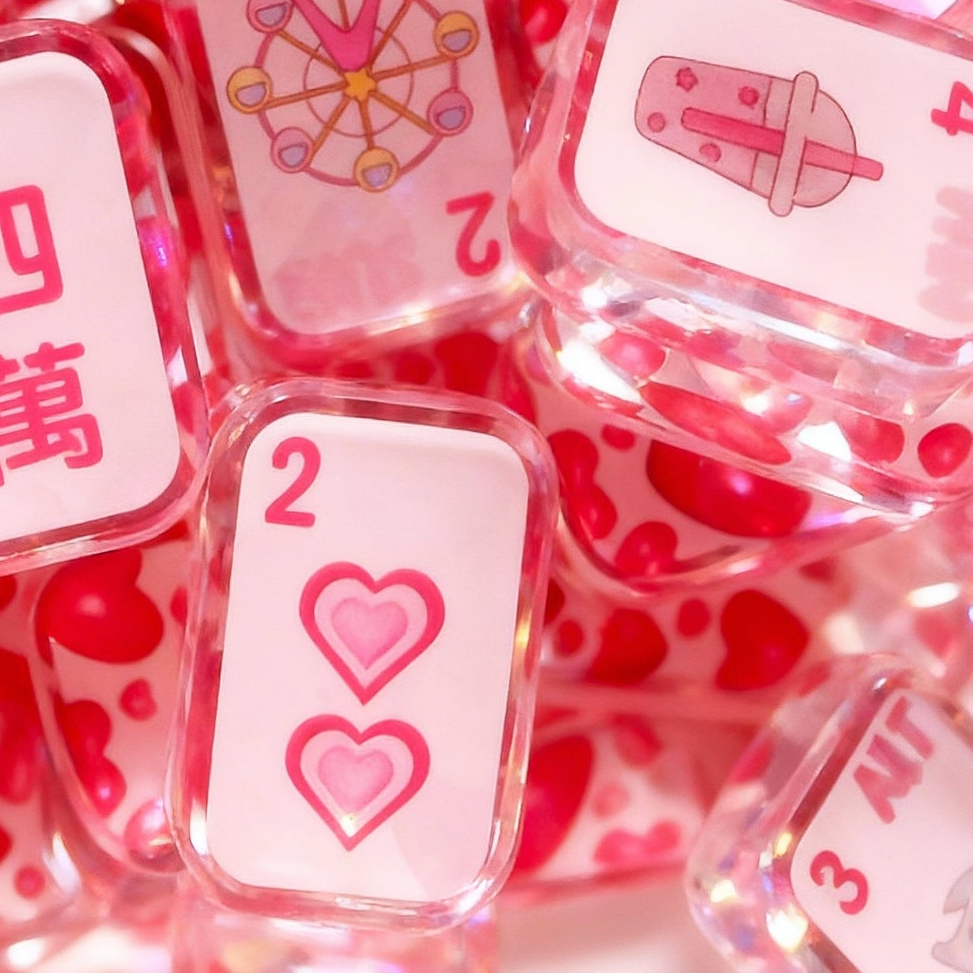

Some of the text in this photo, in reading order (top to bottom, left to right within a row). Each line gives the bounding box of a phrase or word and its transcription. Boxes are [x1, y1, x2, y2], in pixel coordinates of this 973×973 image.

[445, 191, 501, 277] 2
[265, 436, 321, 527] 2
[810, 850, 869, 915] 3
